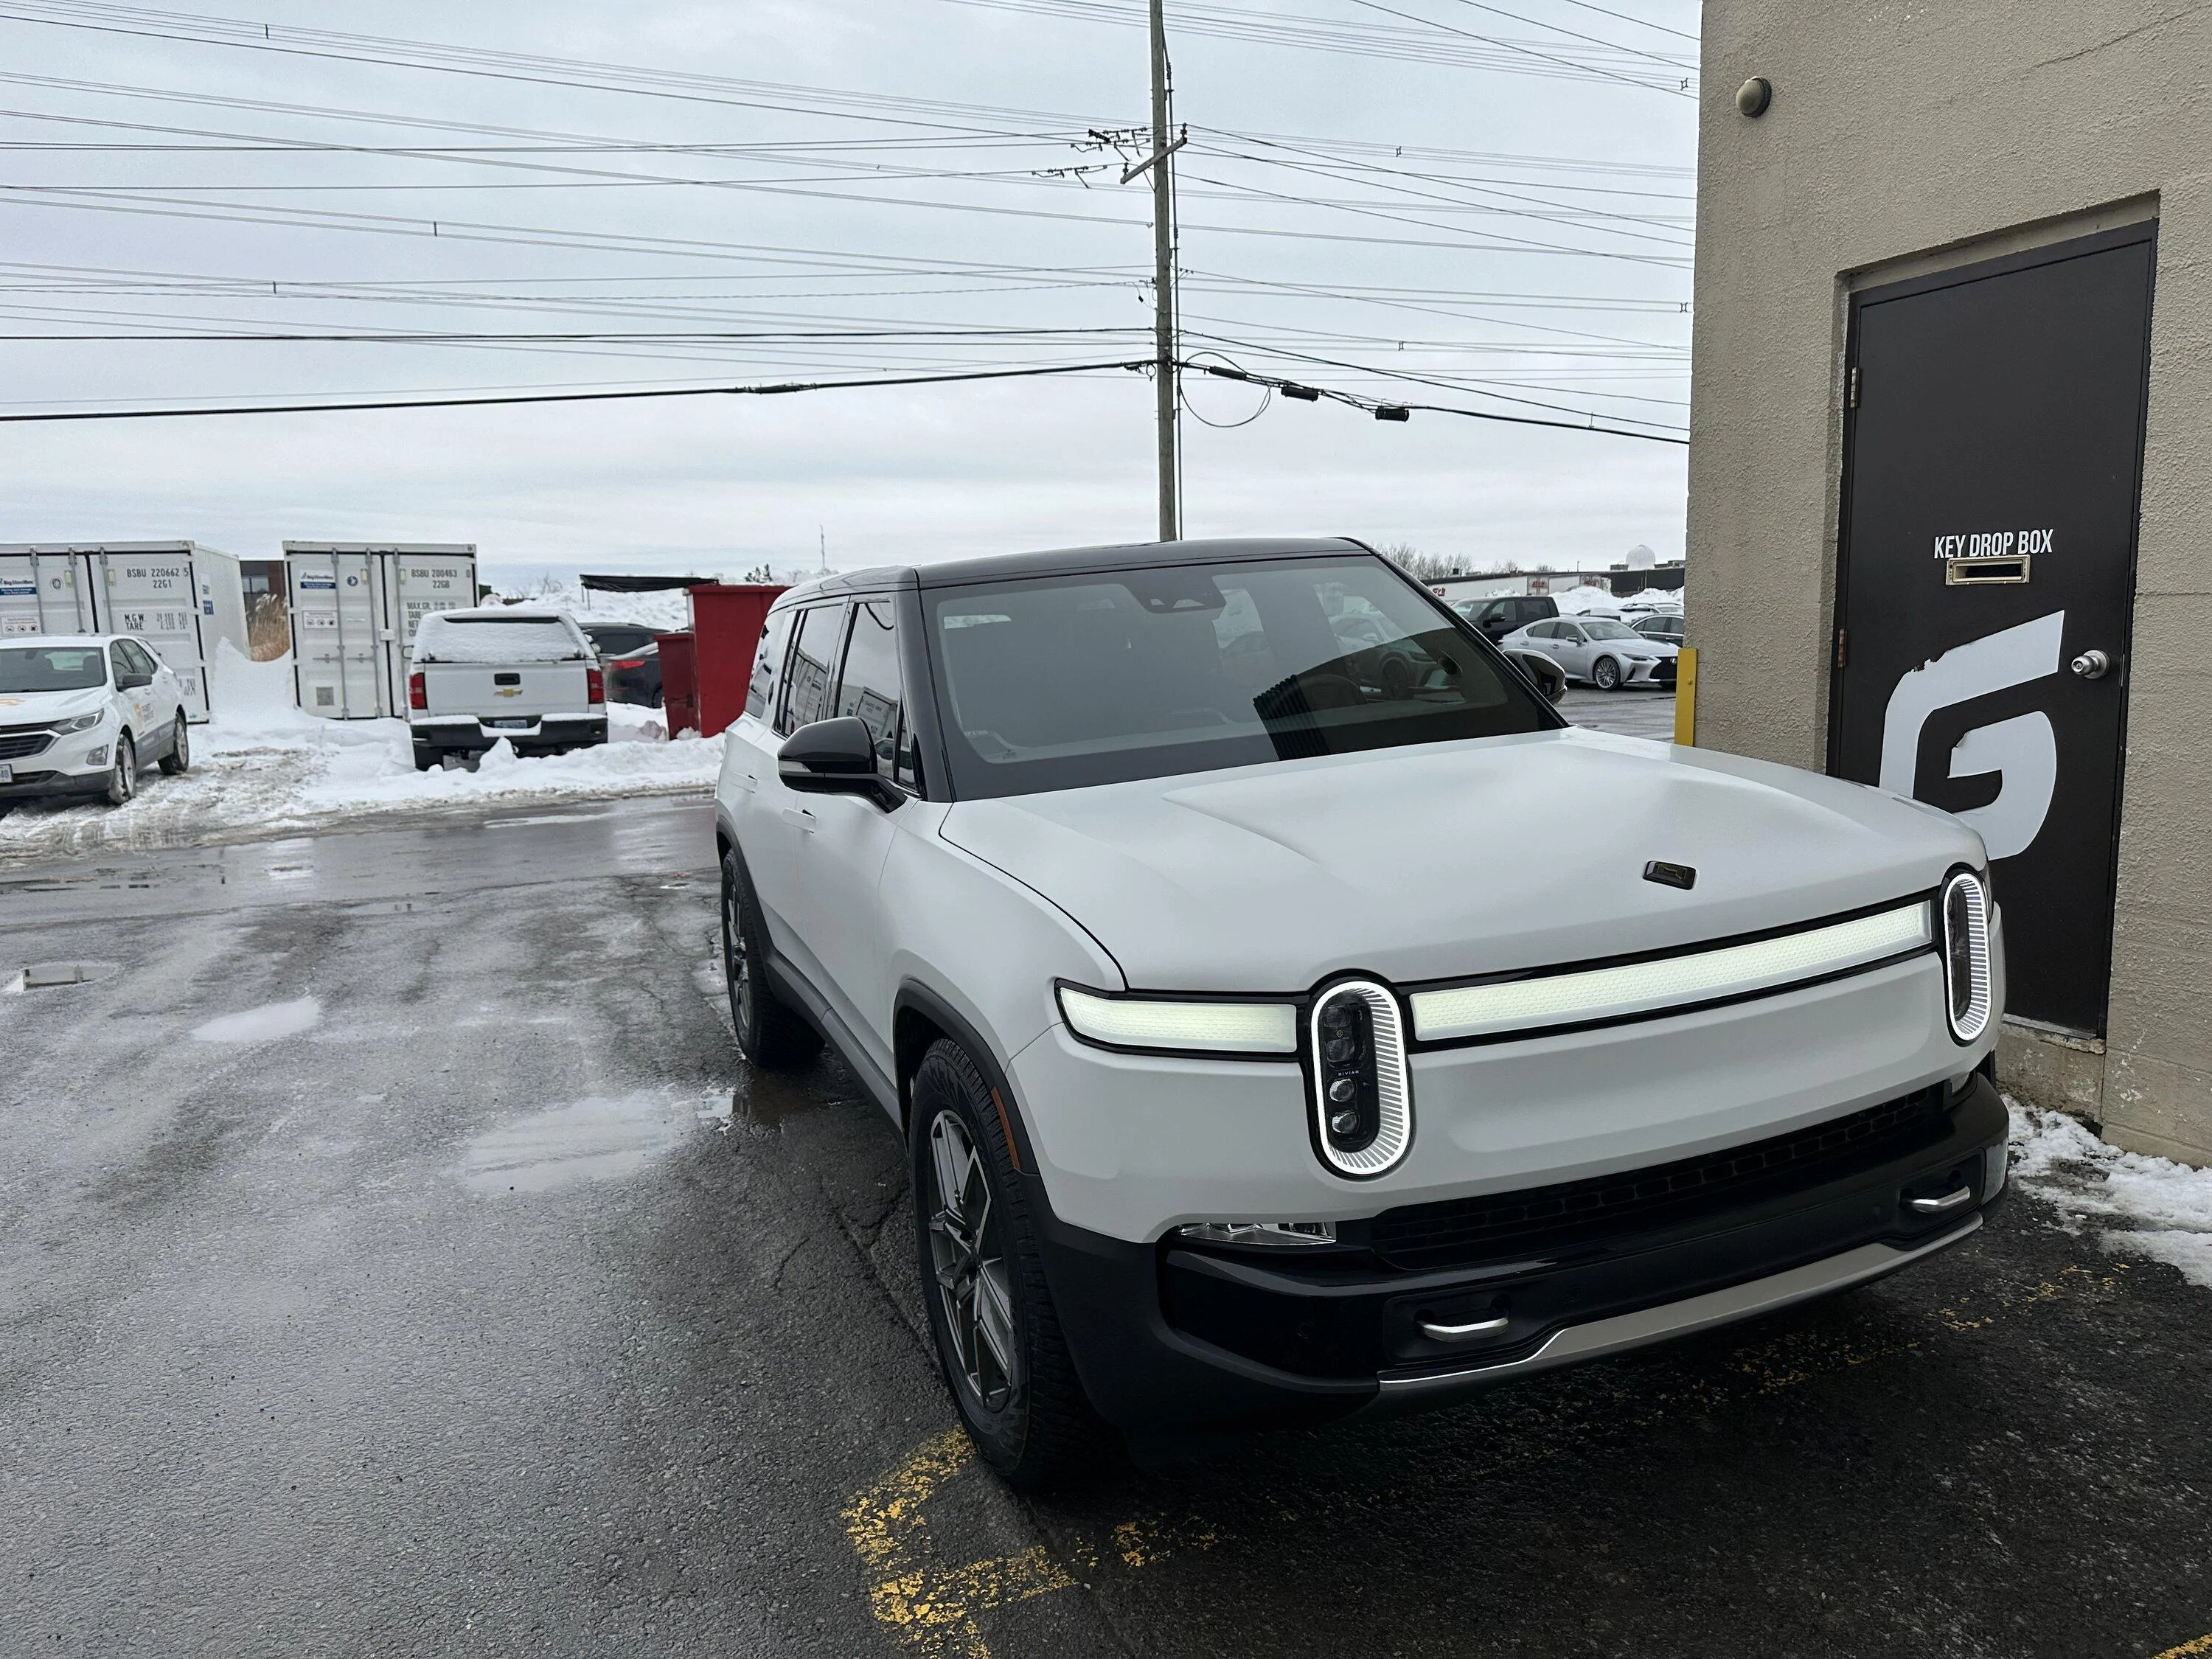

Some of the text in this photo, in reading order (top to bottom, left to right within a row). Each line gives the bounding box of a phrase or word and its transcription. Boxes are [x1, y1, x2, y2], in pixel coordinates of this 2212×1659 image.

[1934, 529, 2053, 559] KEY DROP BOX
[127, 568, 146, 577] BSBU
[151, 568, 179, 577] 220662
[411, 569, 429, 577] BSBU
[1879, 610, 2065, 861] G
